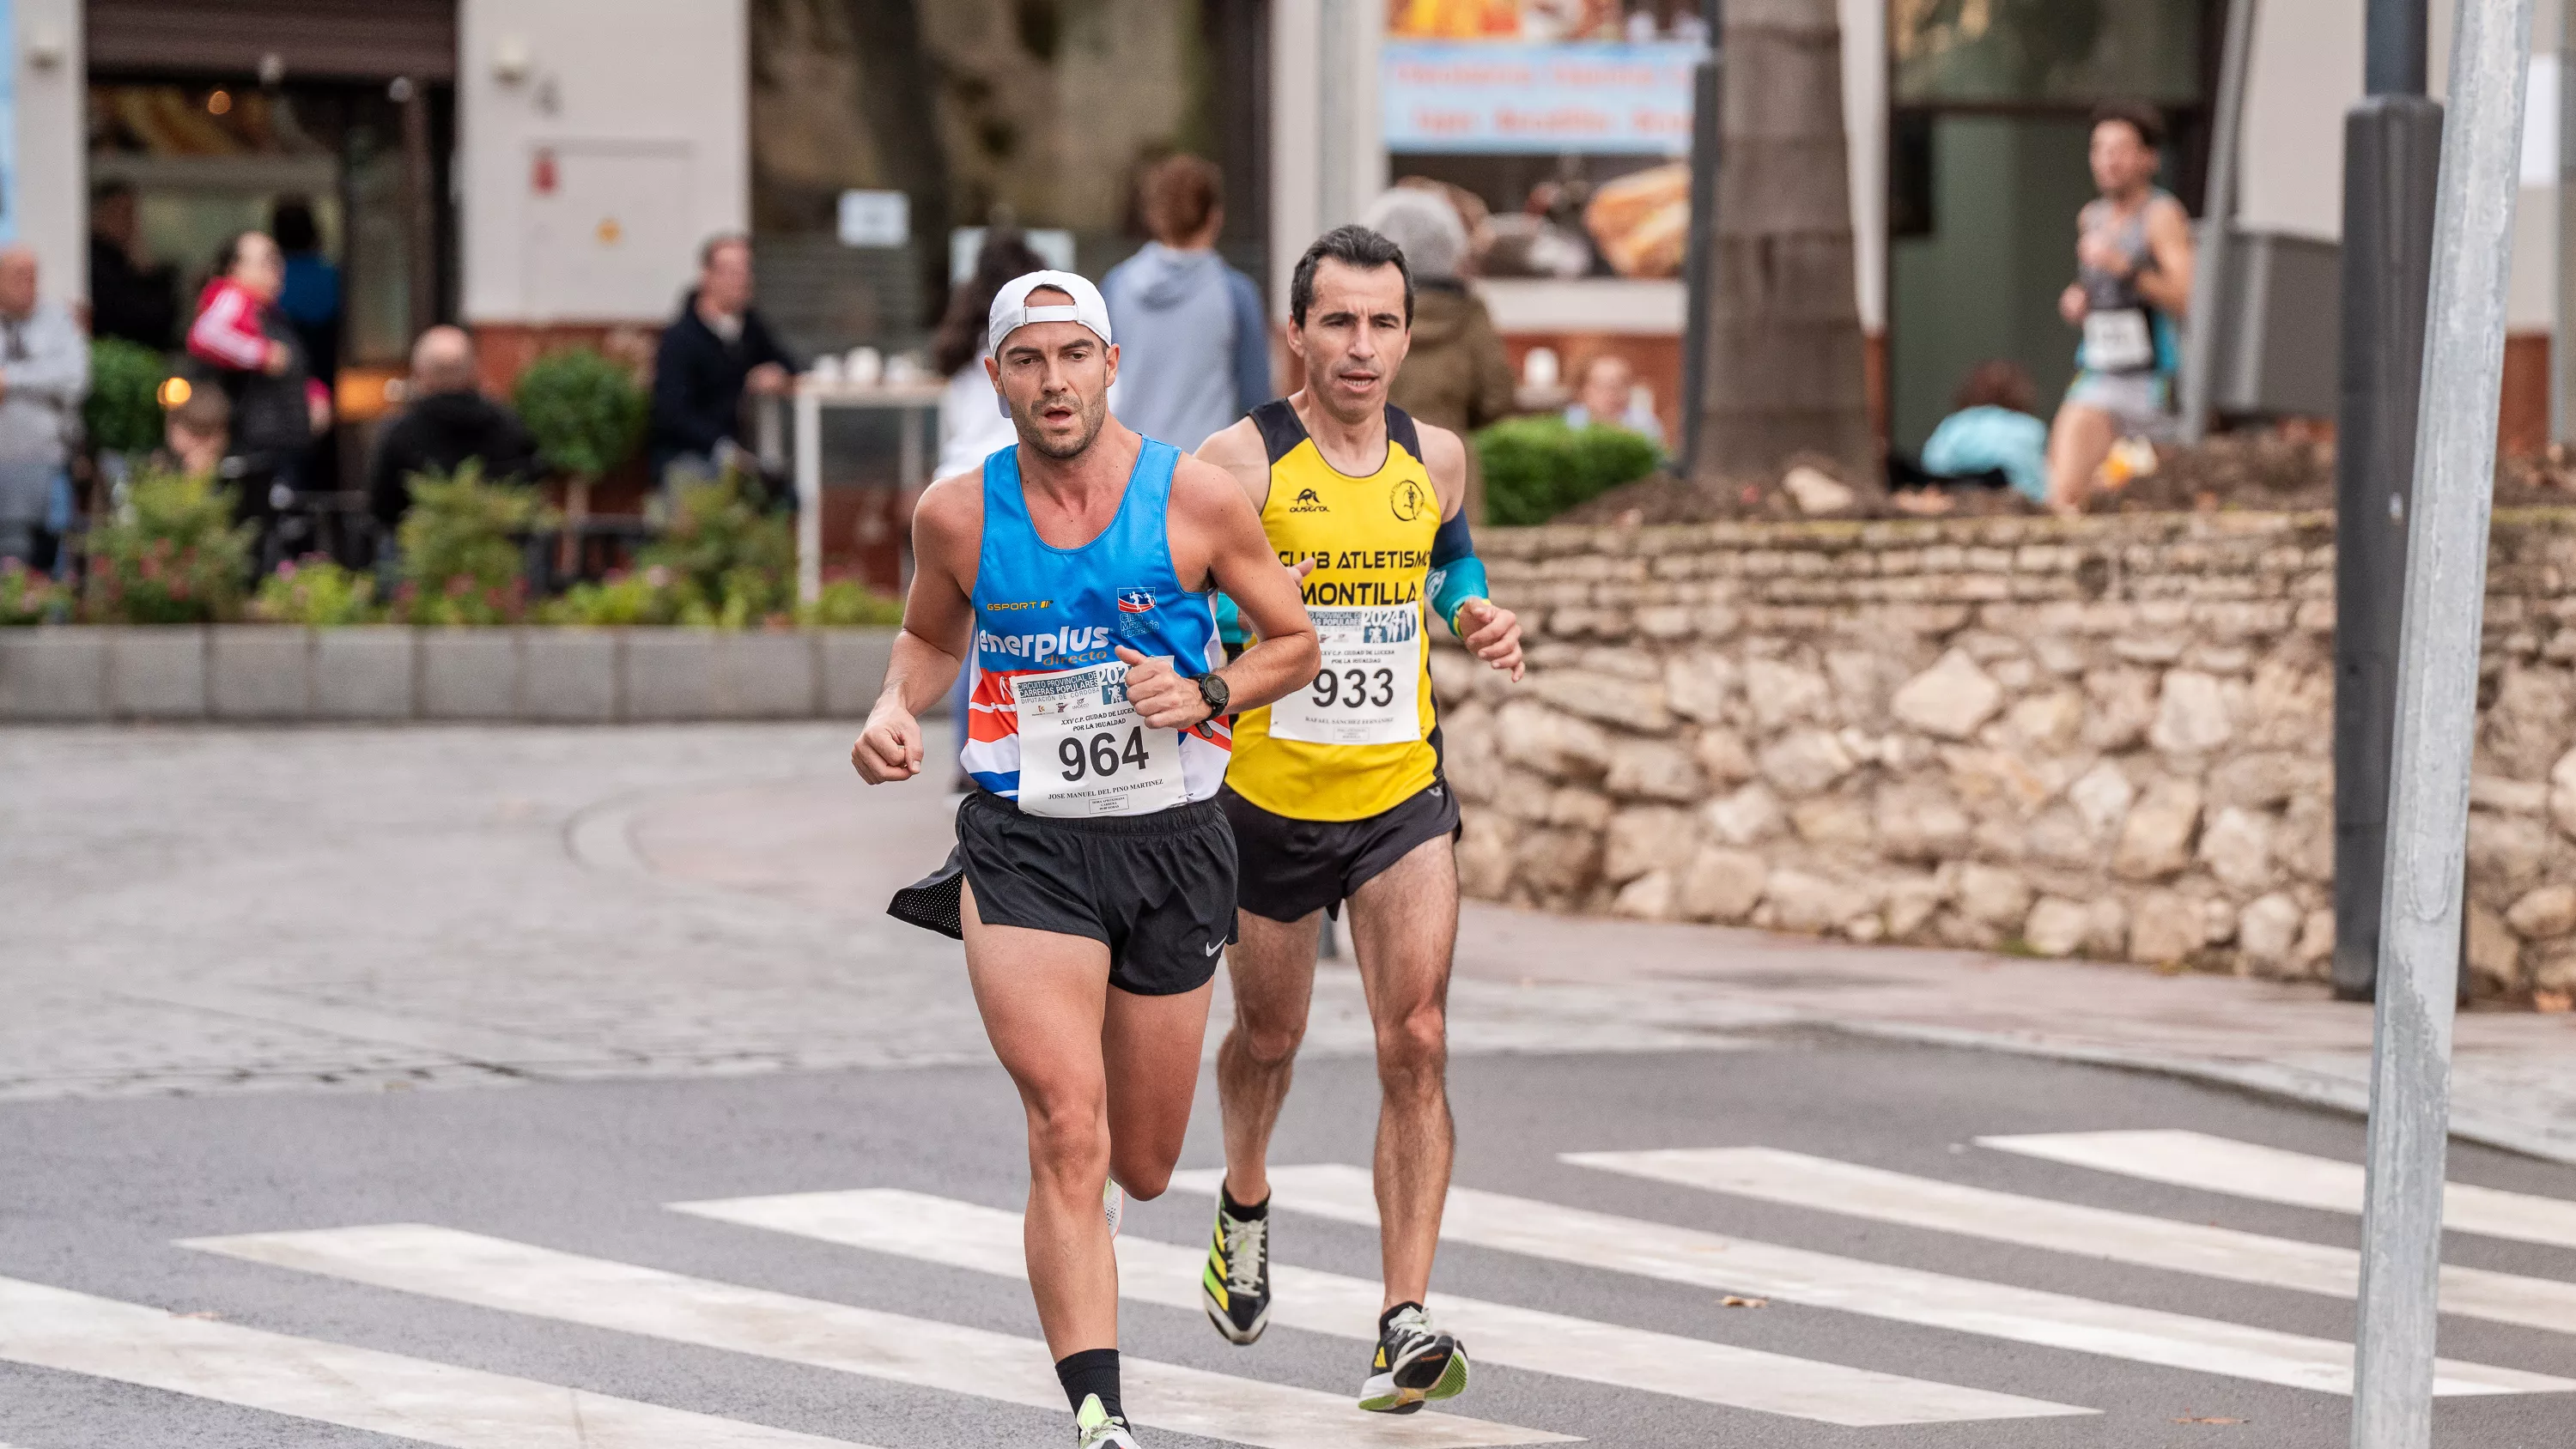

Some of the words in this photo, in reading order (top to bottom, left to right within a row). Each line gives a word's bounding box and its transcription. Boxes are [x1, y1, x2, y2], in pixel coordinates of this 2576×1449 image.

[1301, 582, 1416, 605] MONTILLA
[1120, 613, 1144, 623] Club
[1363, 610, 1400, 627] 2024
[979, 626, 1109, 663] enerplus
[1042, 651, 1108, 666] directo
[1018, 681, 1046, 691] CIRCUITO
[1048, 675, 1087, 687] PROVINCIAL
[1087, 671, 1097, 680] DE
[1019, 688, 1055, 698] CARRERAS
[1056, 679, 1099, 694] POPULARES
[1312, 668, 1394, 708] 933
[1085, 712, 1108, 721] CIUDAD
[1117, 706, 1136, 716] LUCEN
[1095, 718, 1127, 729] IGUALDAD
[1059, 726, 1149, 782] 964
[1066, 790, 1097, 799] MANUEL
[1112, 785, 1129, 793] PINO
[1130, 779, 1164, 791] MARTINEZ
